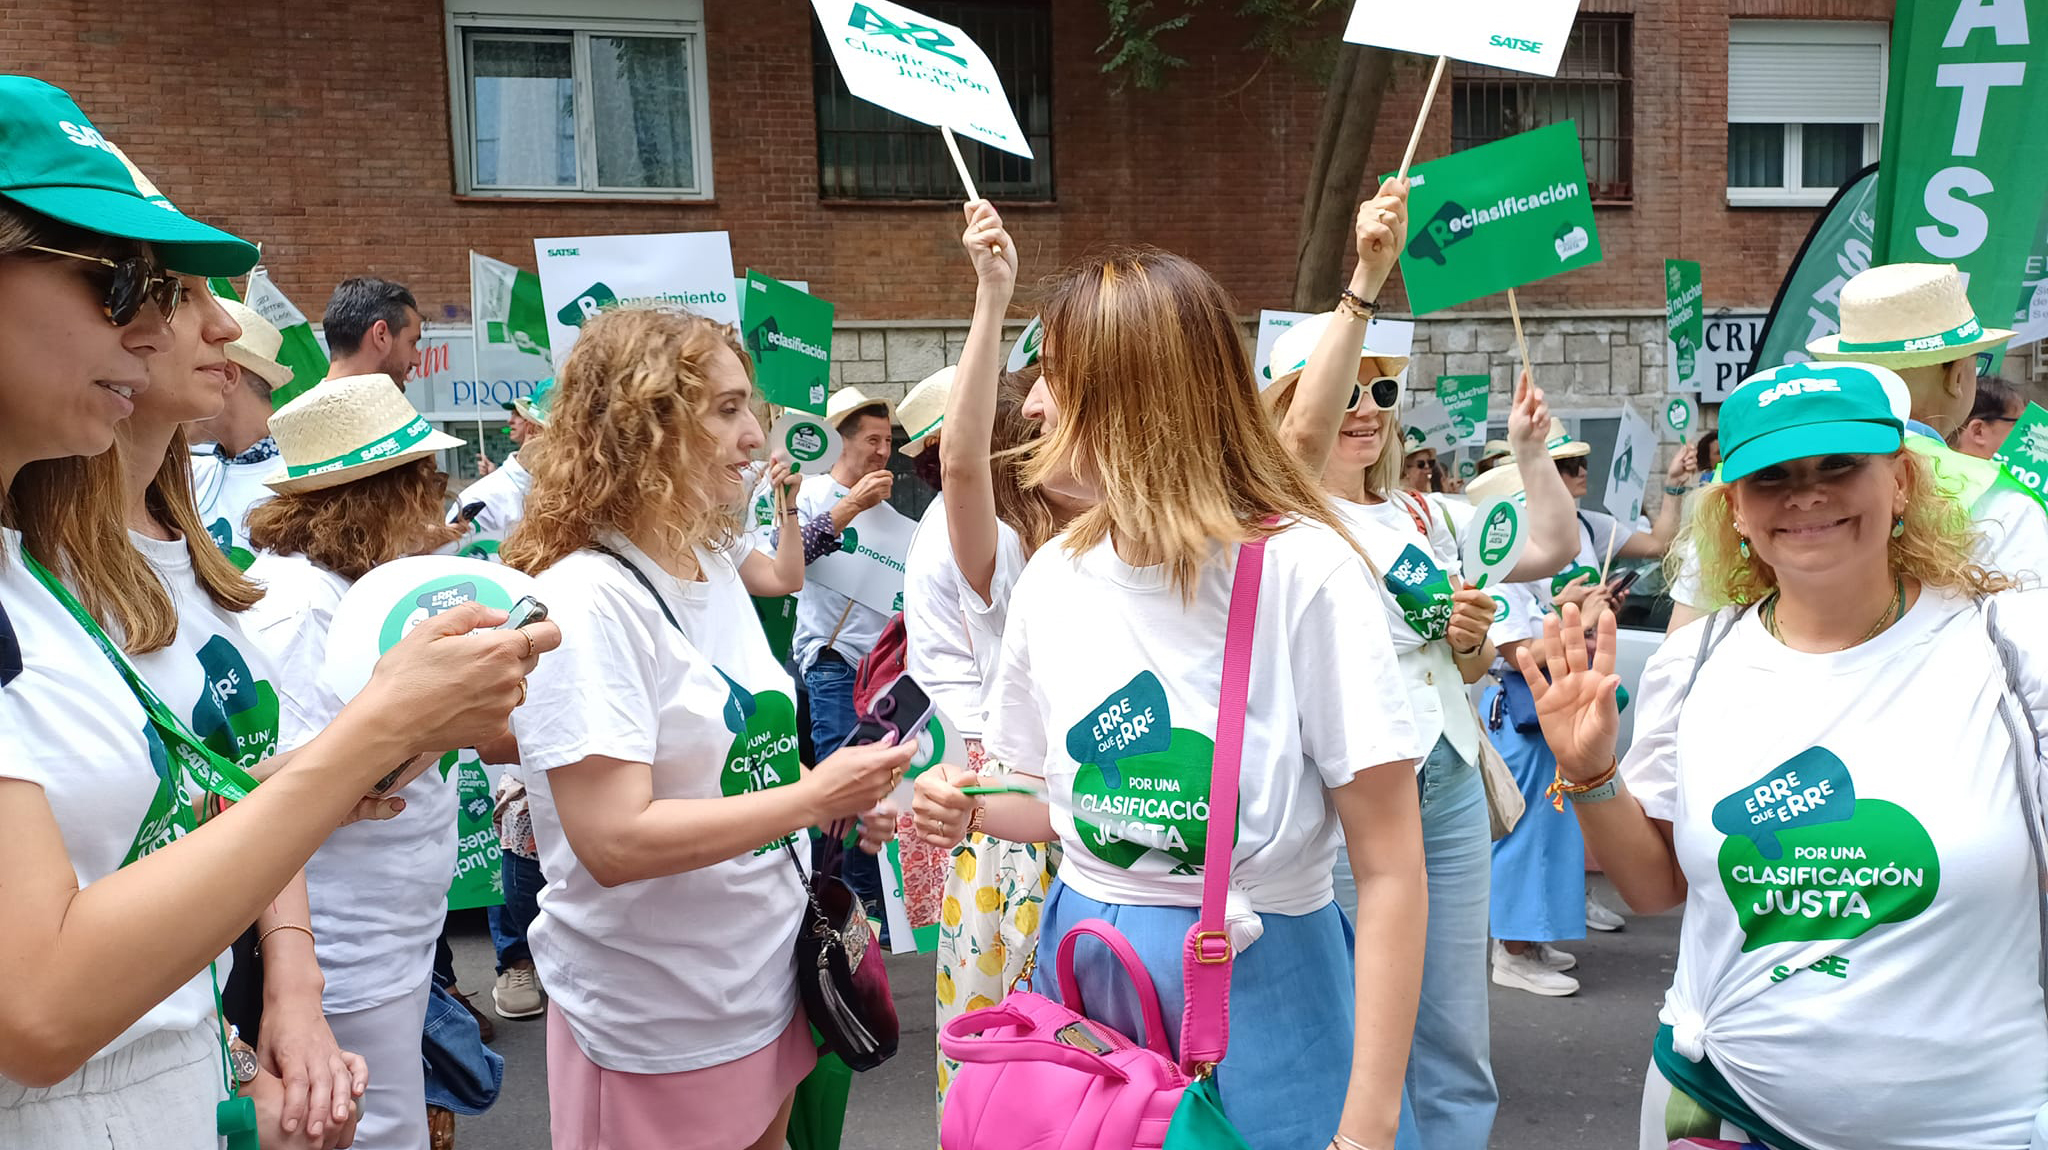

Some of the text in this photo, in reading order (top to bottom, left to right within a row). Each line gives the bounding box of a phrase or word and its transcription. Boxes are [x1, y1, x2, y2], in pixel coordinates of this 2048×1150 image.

[1488, 34, 1543, 54] SATSE
[1427, 182, 1579, 249] Reclasificación
[547, 248, 580, 257] SATSE
[758, 325, 827, 361] Reclasificación
[454, 379, 539, 406] PROD
[1758, 377, 1841, 408] SATSE
[1092, 697, 1132, 741] ERRE
[1098, 706, 1155, 753] QUE ERRE
[176, 743, 223, 788] SATSE
[458, 770, 481, 780] JUST
[1129, 777, 1181, 793] POR UNA
[1744, 771, 1801, 814] ERRE
[1080, 793, 1209, 822] CLASIFICACIÓ
[1751, 779, 1834, 825] QUE ERRE
[1092, 822, 1189, 853] JUSTA
[453, 850, 488, 880] luch
[1794, 847, 1867, 860] POR UNA
[1731, 861, 1924, 887] CLASIFICACIÓN
[1752, 889, 1871, 919] JUSTA
